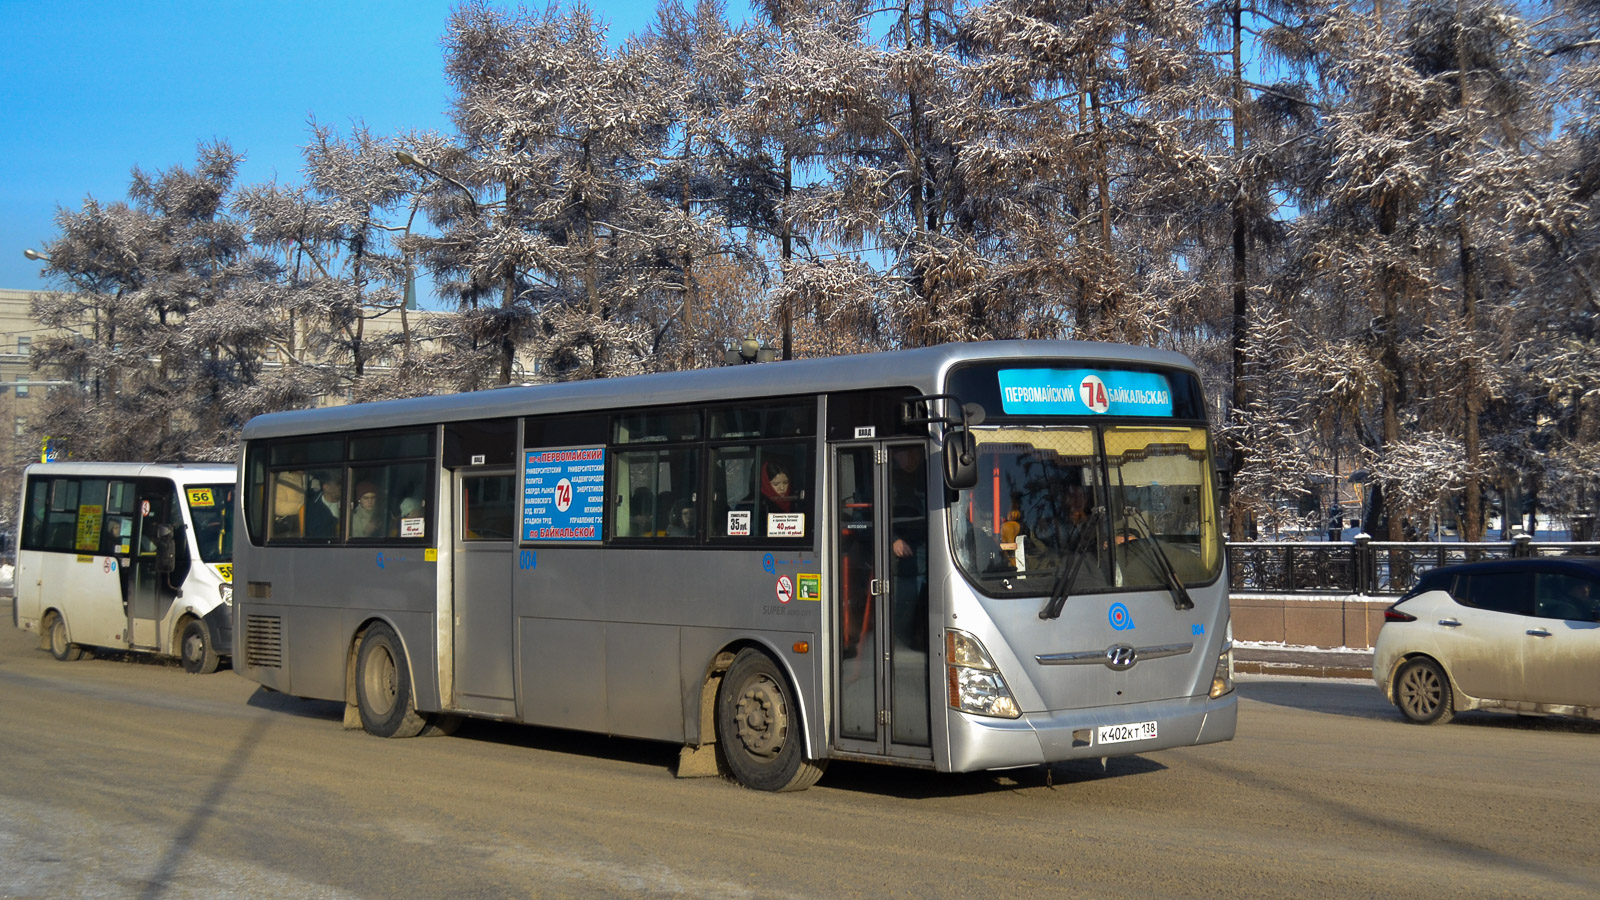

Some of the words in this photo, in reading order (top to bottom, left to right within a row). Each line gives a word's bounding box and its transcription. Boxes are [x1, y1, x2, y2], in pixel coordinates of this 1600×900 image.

[1005, 384, 1076, 402] ПЕРВОМАЙСКИЙ
[1082, 382, 1108, 408] 74
[1108, 386, 1168, 404] БАЙКАЛЬСКАЯ
[542, 449, 602, 462] ПЕРВОМАЙСКИЙ
[568, 464, 604, 472] УНИВЕРСИТЕТСКИЙ
[571, 475, 604, 483] АКАДЕМГОРОДОК
[193, 490, 209, 501] 56
[557, 485, 570, 506] 74
[731, 519, 739, 530] 35
[540, 525, 595, 538] БАЙКАЛЬСКОЙ
[520, 550, 537, 570] 004
[762, 605, 786, 615] SUPER
[1192, 624, 1204, 635] 004
[1102, 726, 1139, 741] К402КТ
[1142, 723, 1156, 734] 138
